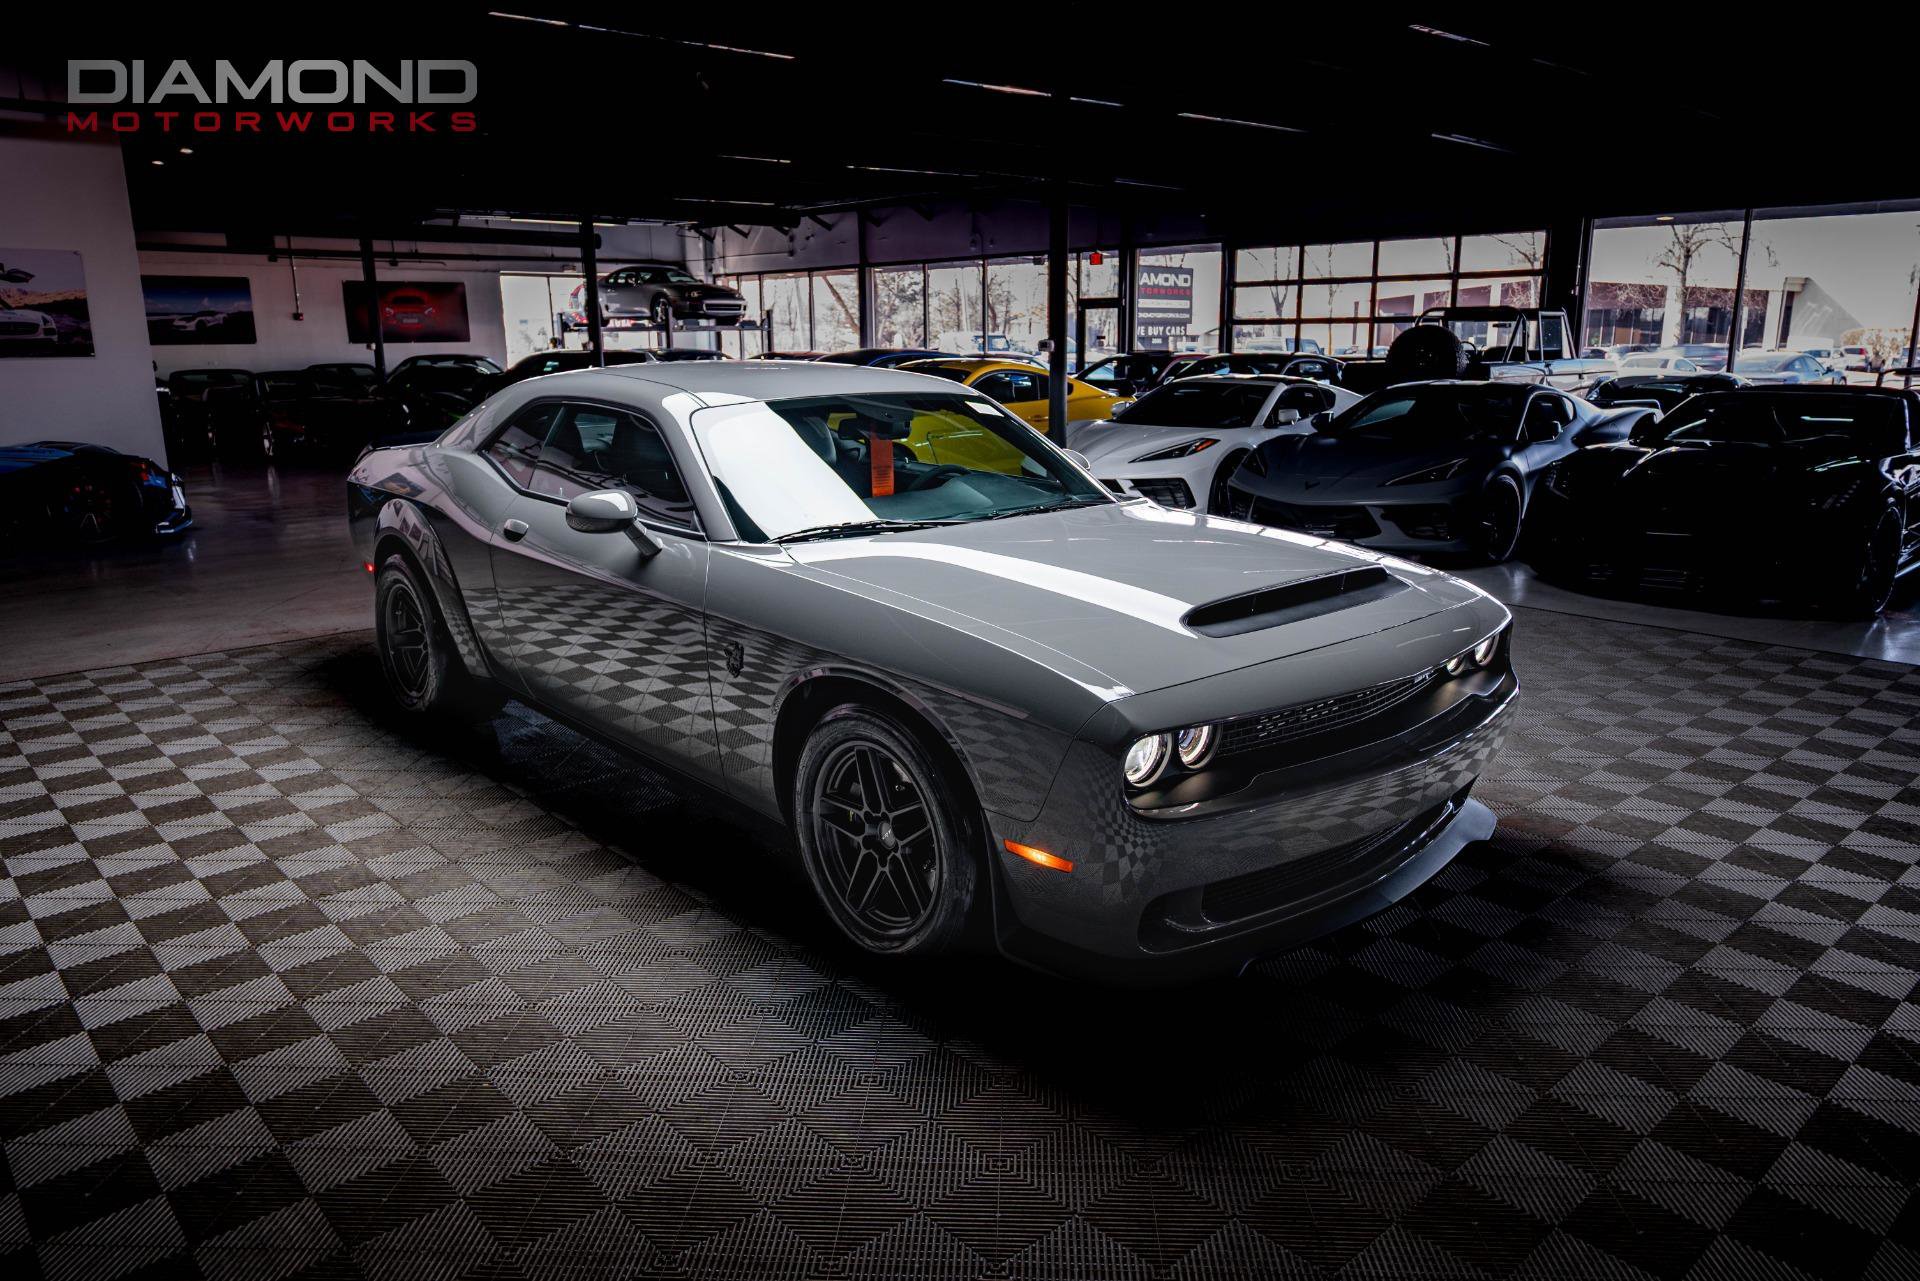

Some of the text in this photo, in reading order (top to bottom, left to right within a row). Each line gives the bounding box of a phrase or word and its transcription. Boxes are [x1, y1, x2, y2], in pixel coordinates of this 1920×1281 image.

[1139, 272, 1191, 287] AMOND
[1148, 326, 1164, 336] BUY
[1165, 326, 1186, 336] CARS
